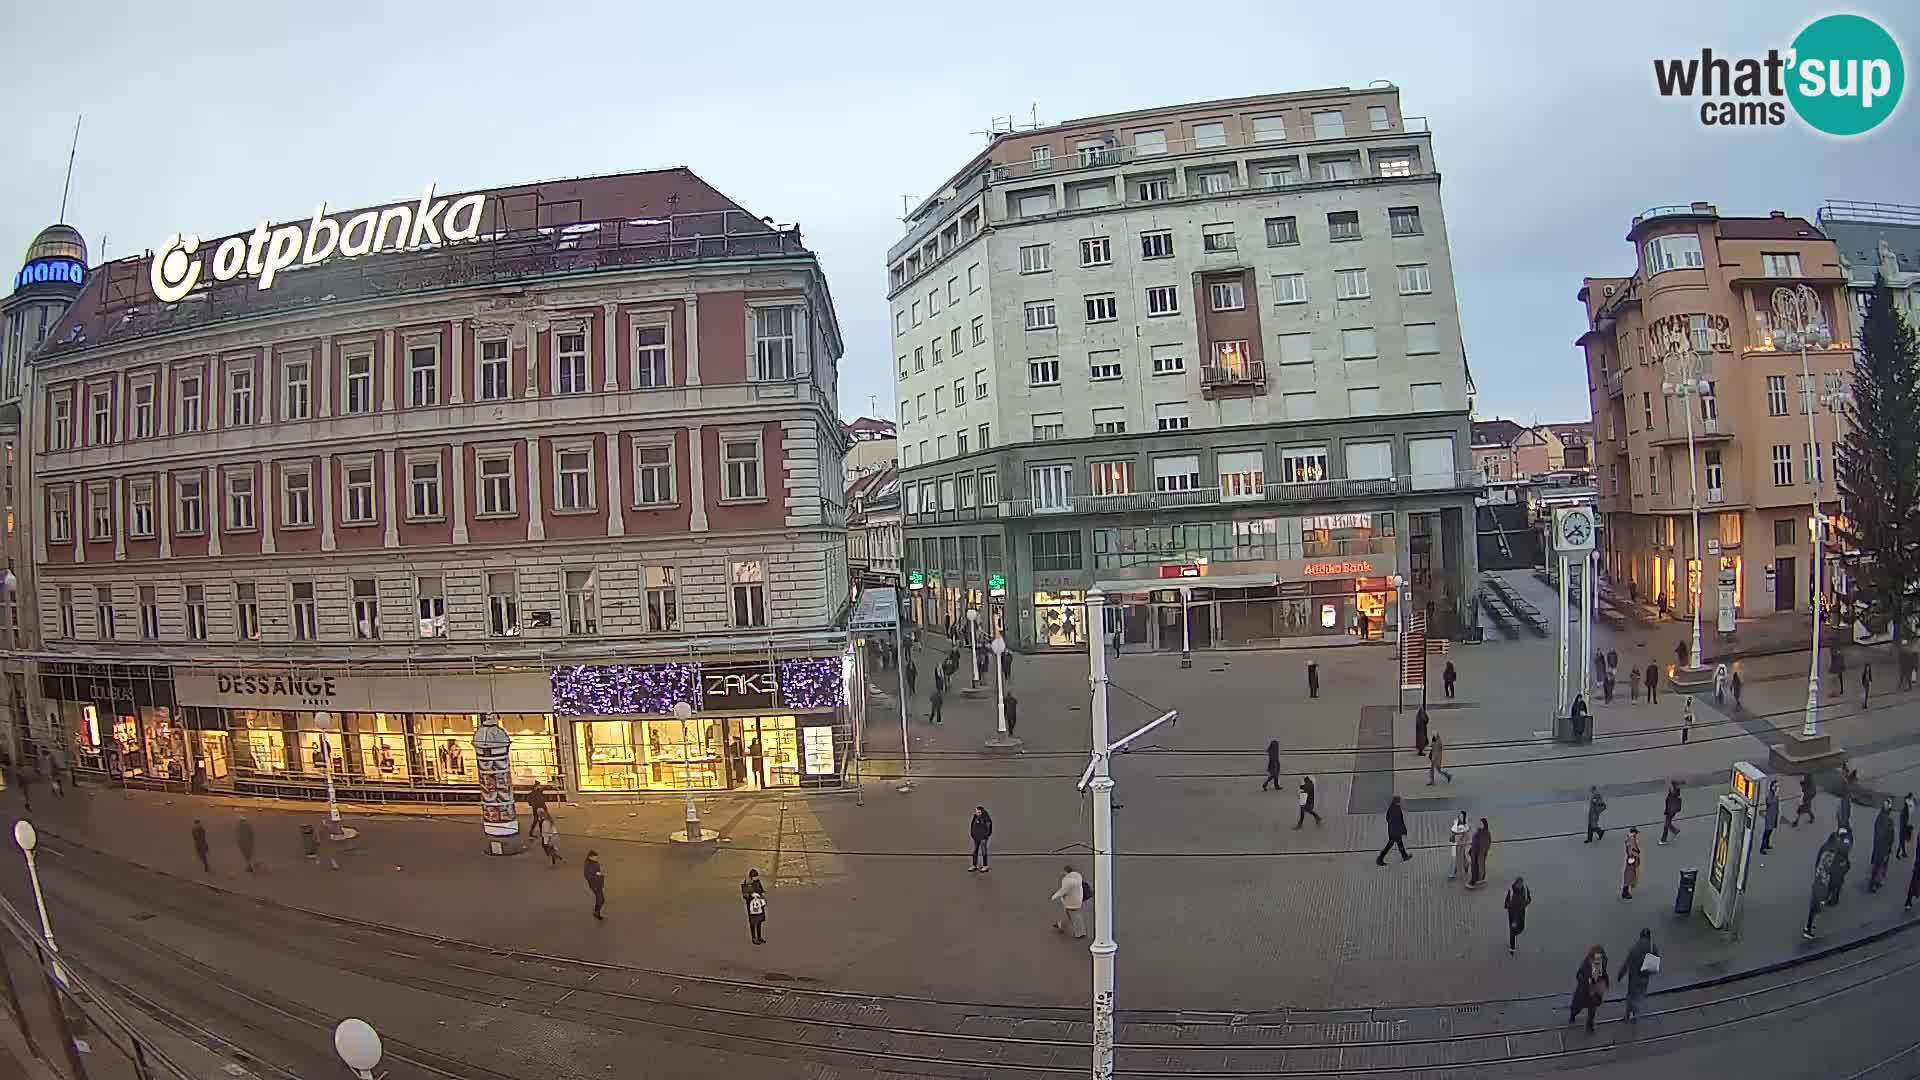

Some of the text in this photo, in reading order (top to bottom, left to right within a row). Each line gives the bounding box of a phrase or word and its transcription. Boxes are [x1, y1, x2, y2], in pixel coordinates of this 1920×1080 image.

[1343, 561, 1372, 573] Bank
[218, 674, 336, 696] DESSANGE
[706, 673, 777, 696] ZAKS
